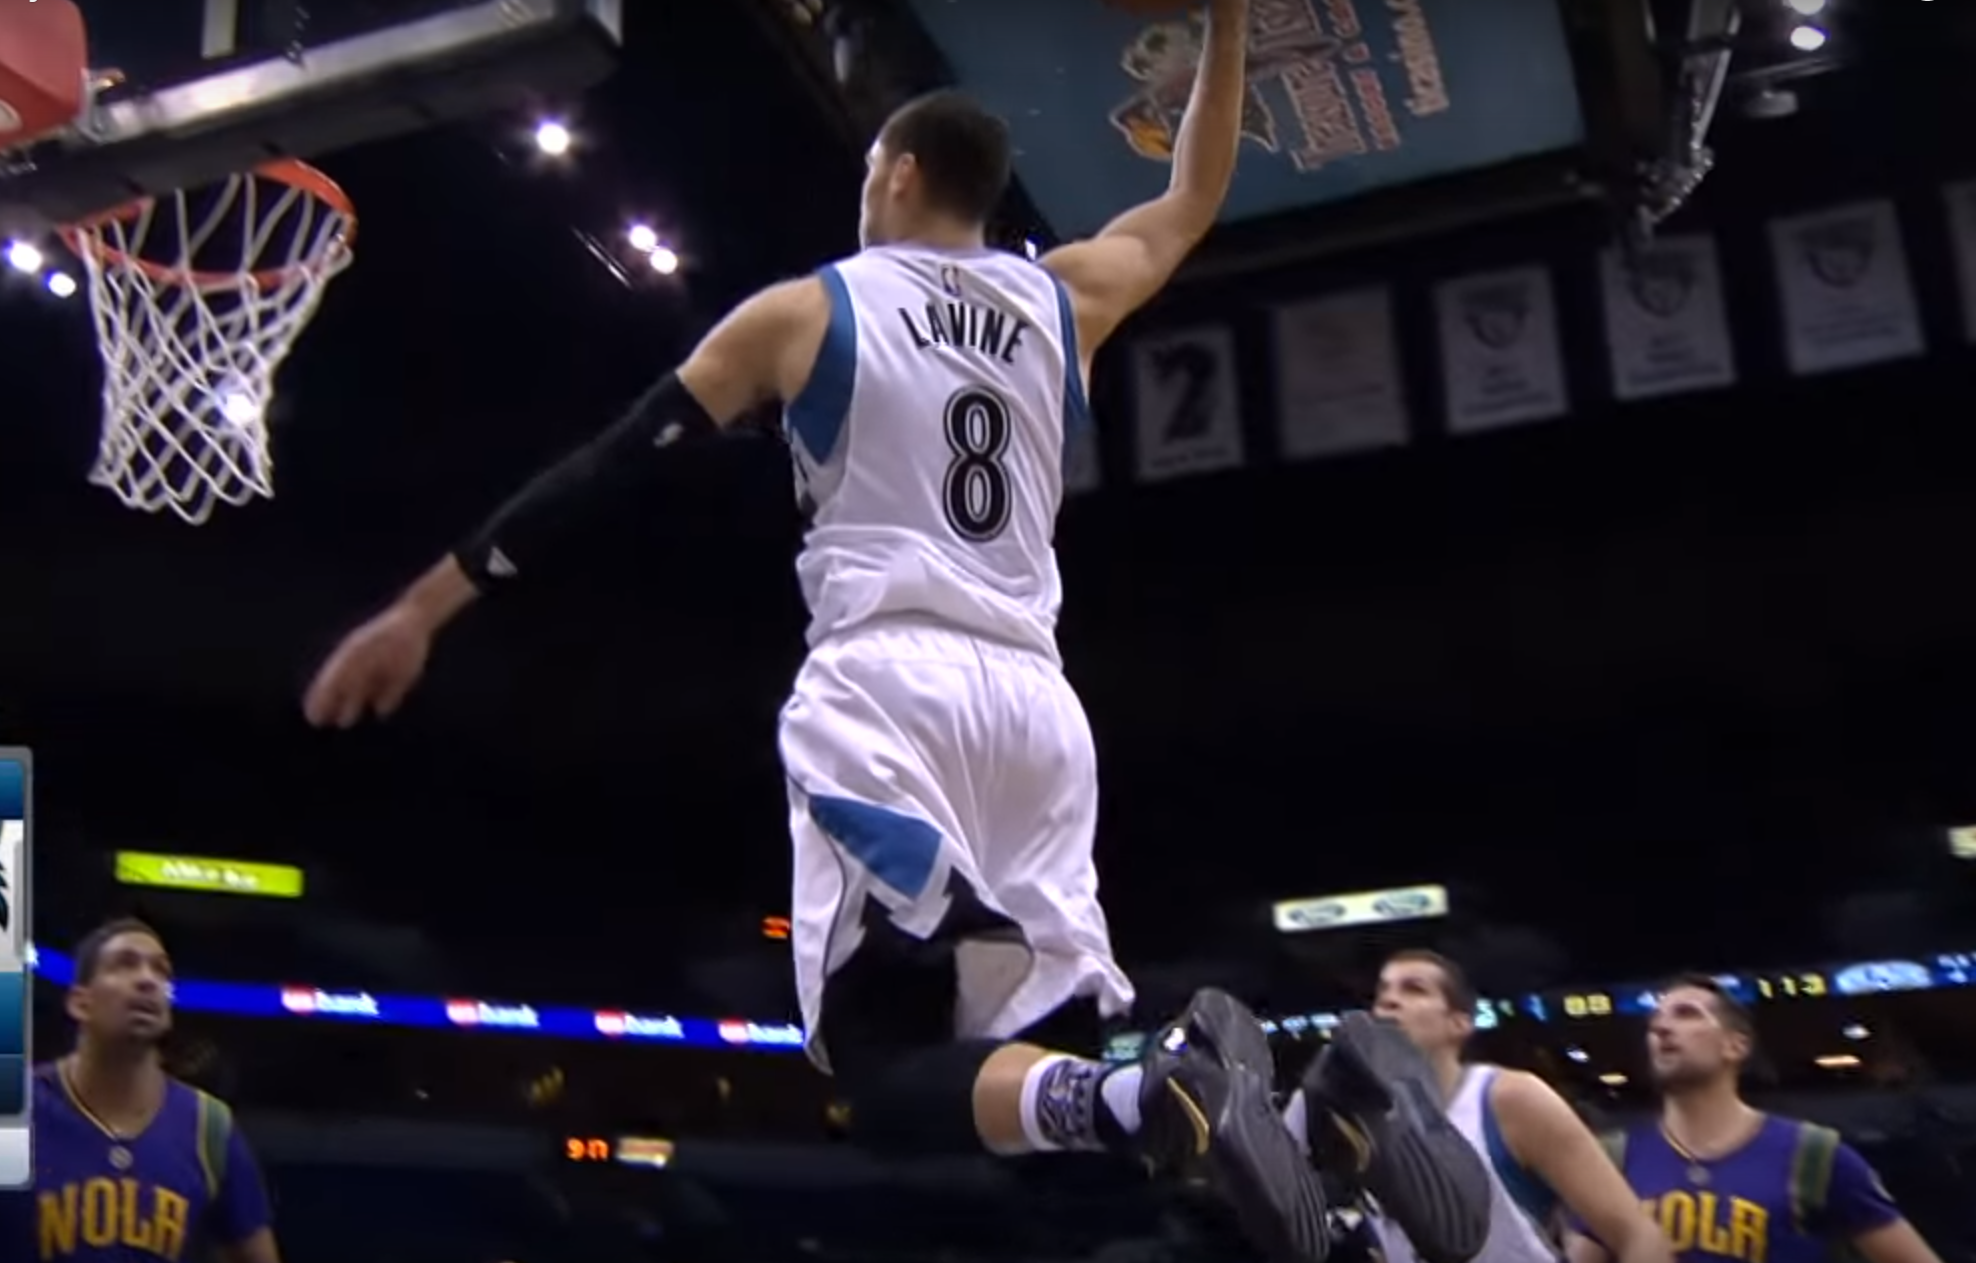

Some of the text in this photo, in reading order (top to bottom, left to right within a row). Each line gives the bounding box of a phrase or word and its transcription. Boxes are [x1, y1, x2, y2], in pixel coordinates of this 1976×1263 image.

[898, 303, 1029, 364] LAVINE
[942, 384, 1012, 543] 8
[37, 1176, 190, 1263] NOLA
